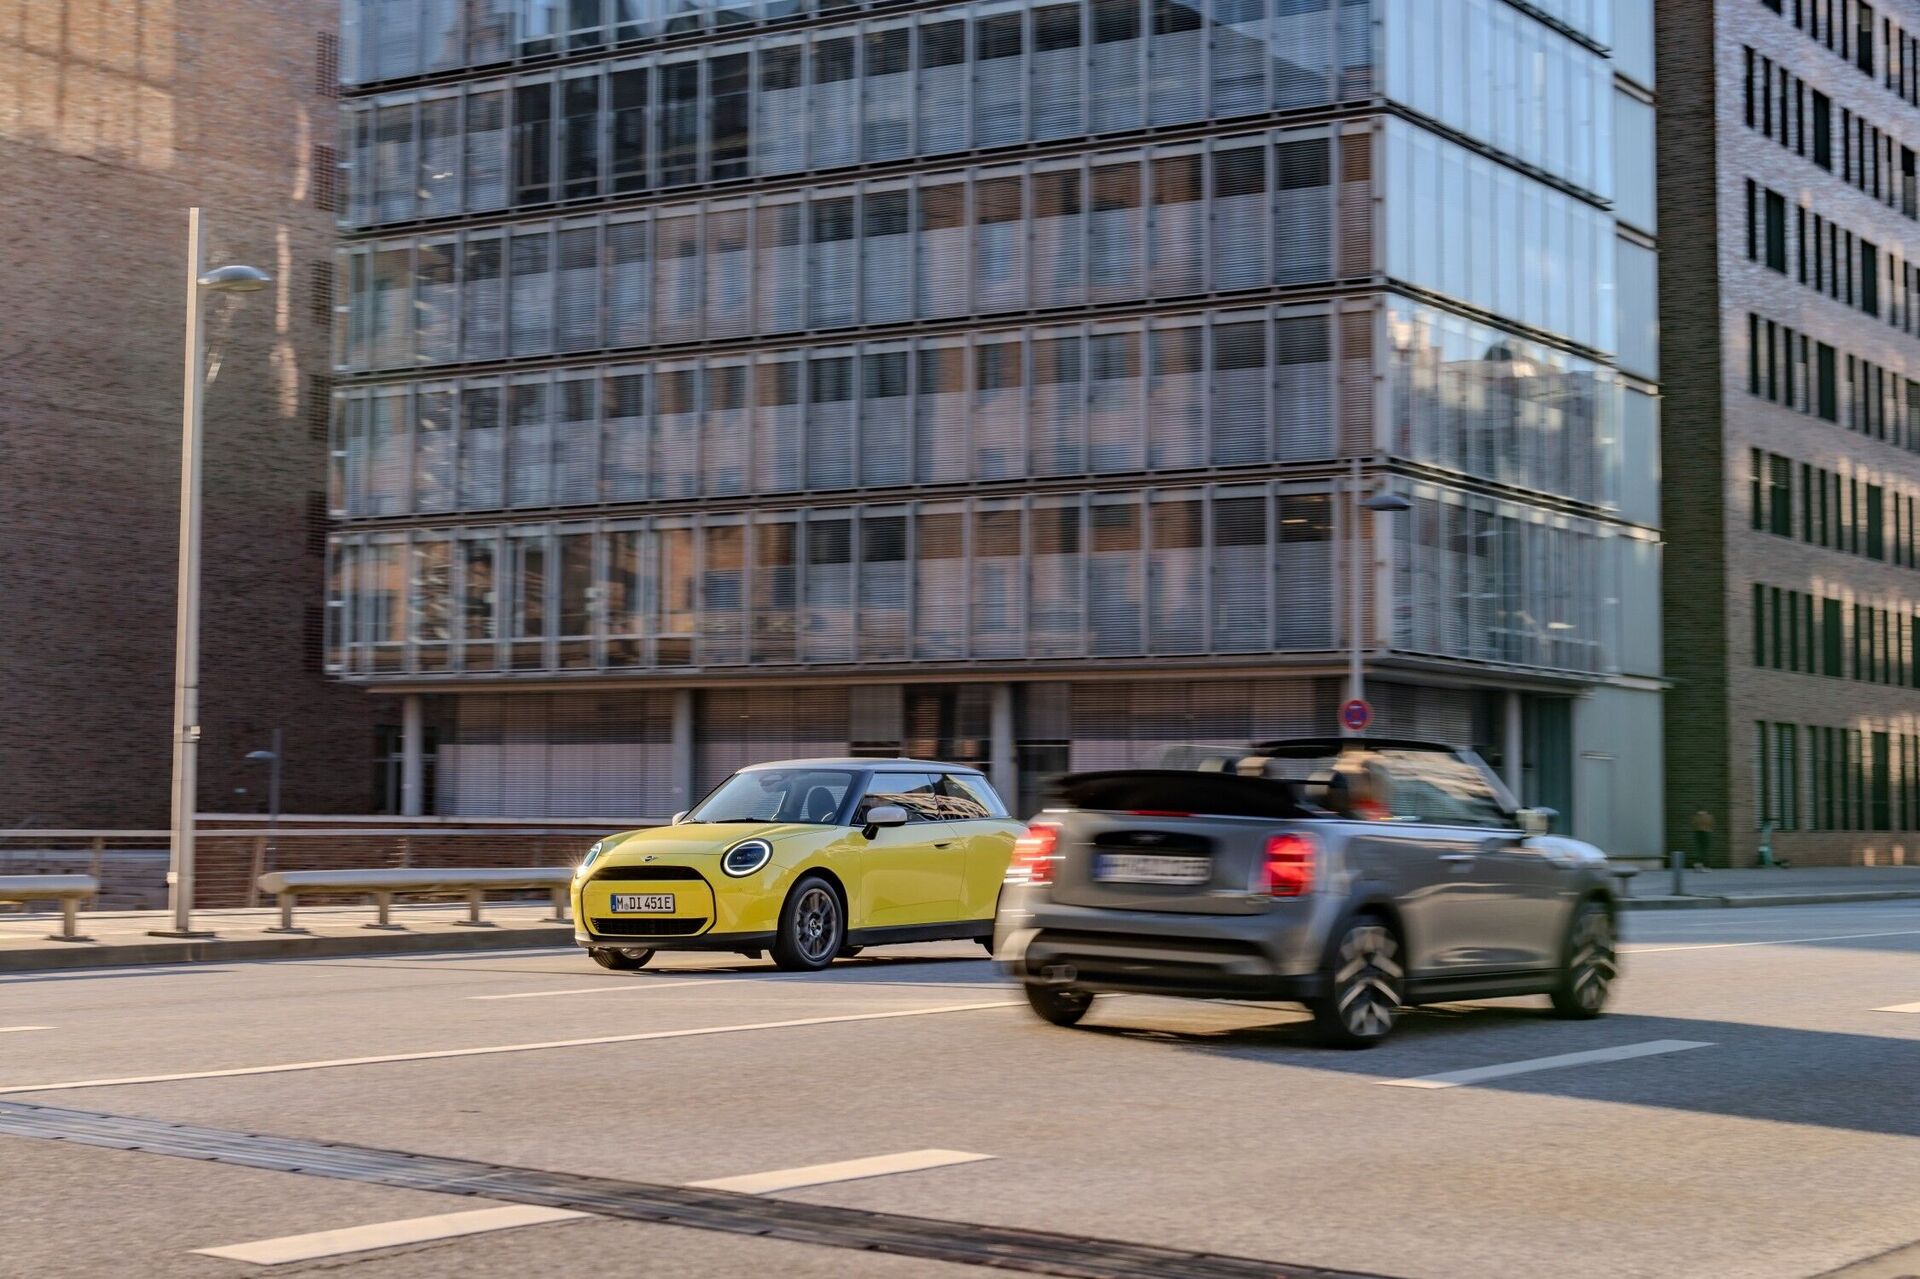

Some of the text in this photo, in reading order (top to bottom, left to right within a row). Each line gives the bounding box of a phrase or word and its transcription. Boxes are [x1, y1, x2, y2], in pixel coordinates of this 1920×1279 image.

[617, 896, 671, 910] M DI 451E
